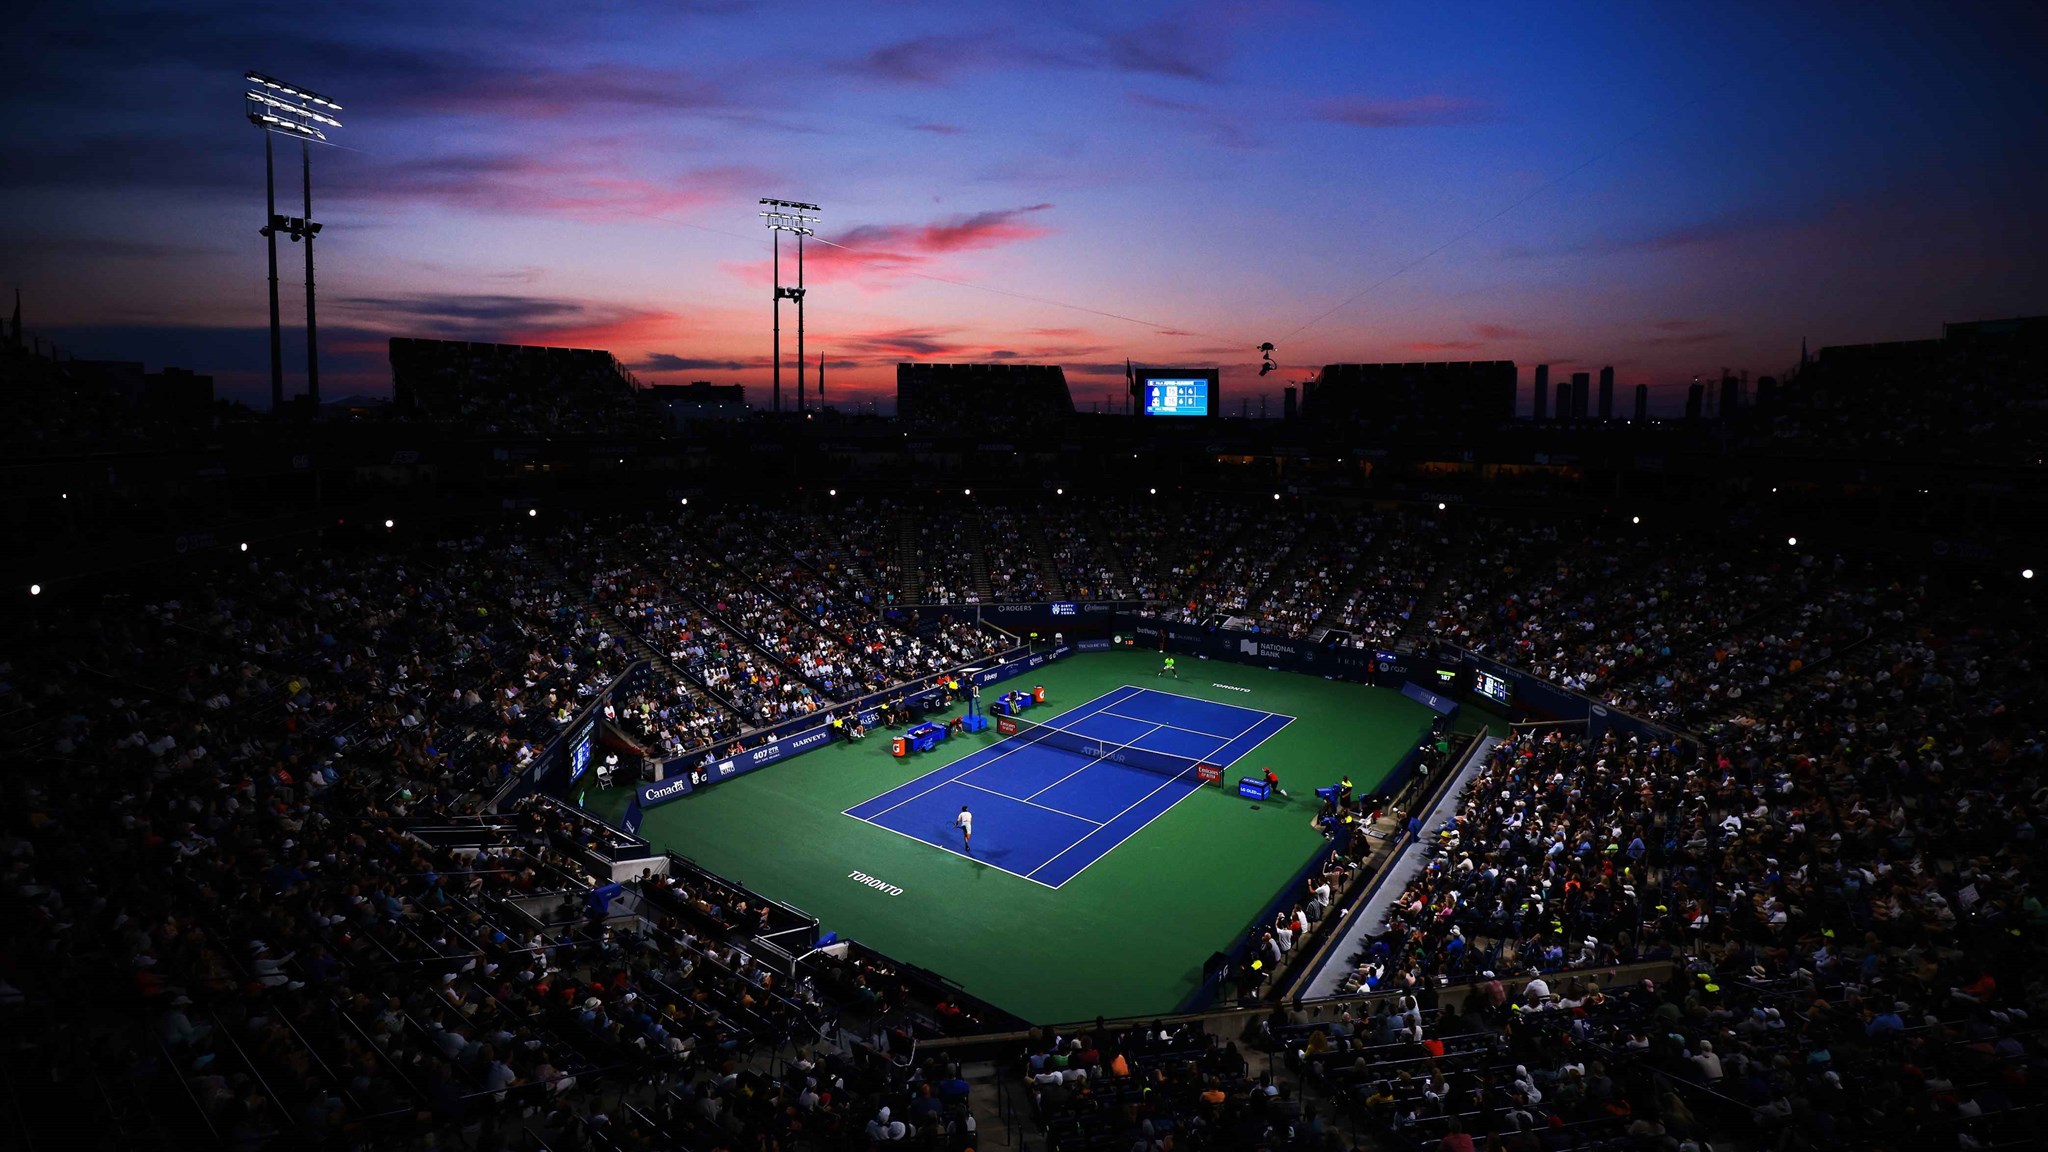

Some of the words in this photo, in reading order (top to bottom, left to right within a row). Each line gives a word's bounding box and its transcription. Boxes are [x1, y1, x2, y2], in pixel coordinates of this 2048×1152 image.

[1136, 626, 1158, 637] betway
[1260, 642, 1296, 654] NATIONAL
[1260, 650, 1281, 658] BANK
[1212, 683, 1251, 693] TORONTO
[792, 732, 827, 748] HARVEY'S
[893, 744, 900, 753] G
[1081, 746, 1101, 757] ATP
[753, 749, 768, 760] 407
[645, 783, 685, 801] Canada
[848, 870, 903, 896] TORONTO
